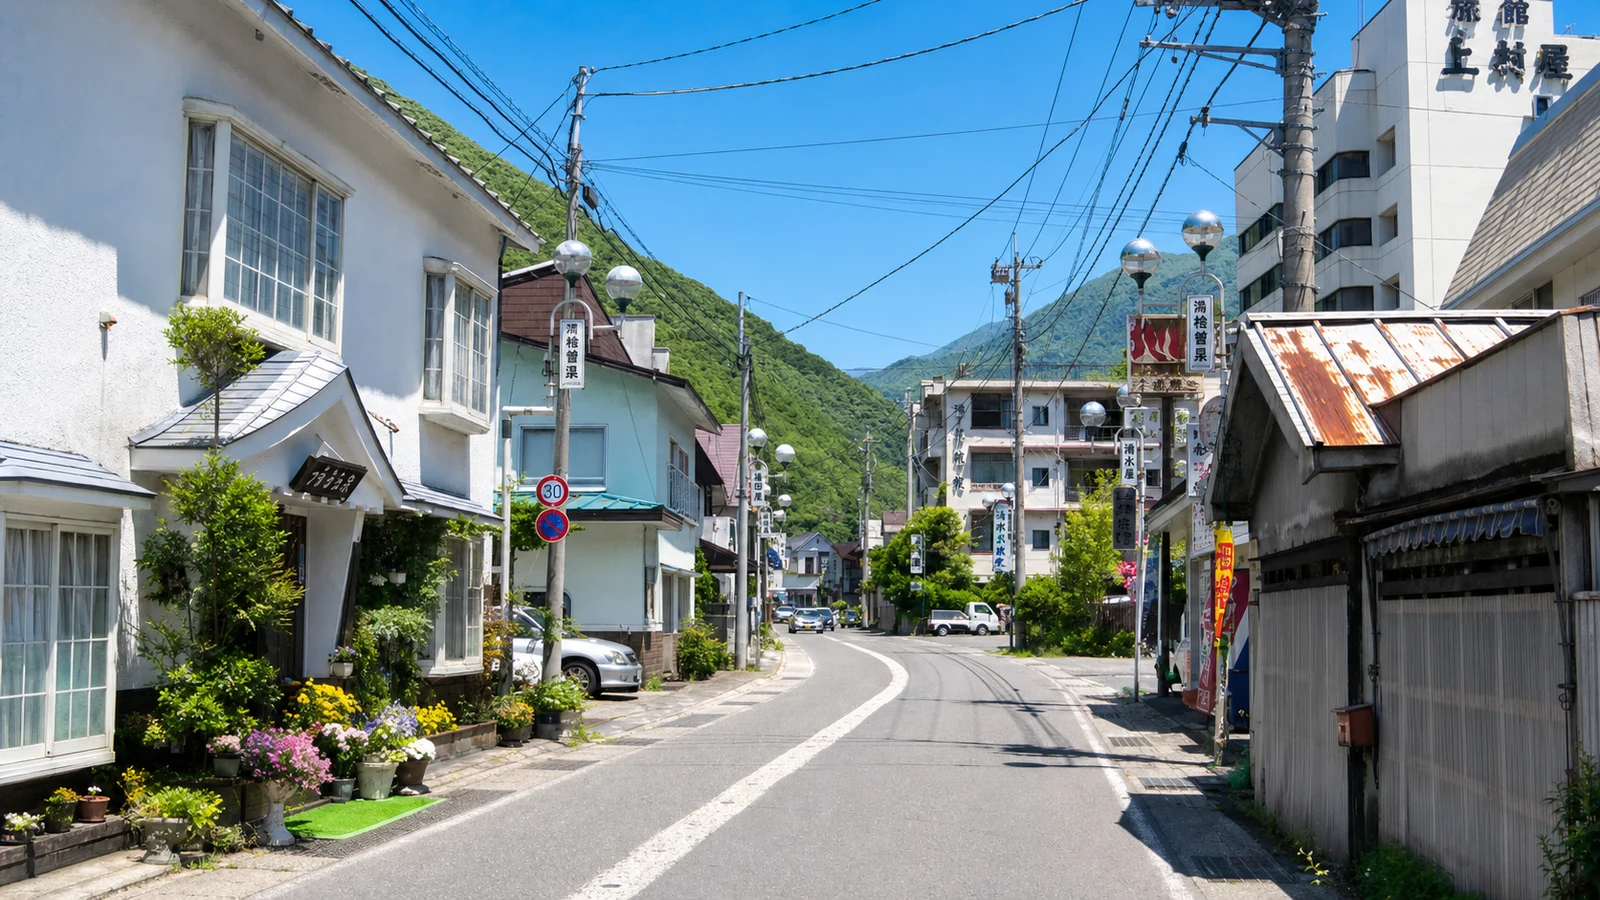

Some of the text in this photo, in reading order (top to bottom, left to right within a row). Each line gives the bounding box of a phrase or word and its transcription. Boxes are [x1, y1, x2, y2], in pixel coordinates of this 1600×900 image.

[1449, 0, 1530, 25] 旅館
[1123, 443, 1136, 480] 清水屋
[543, 484, 562, 499] 30
